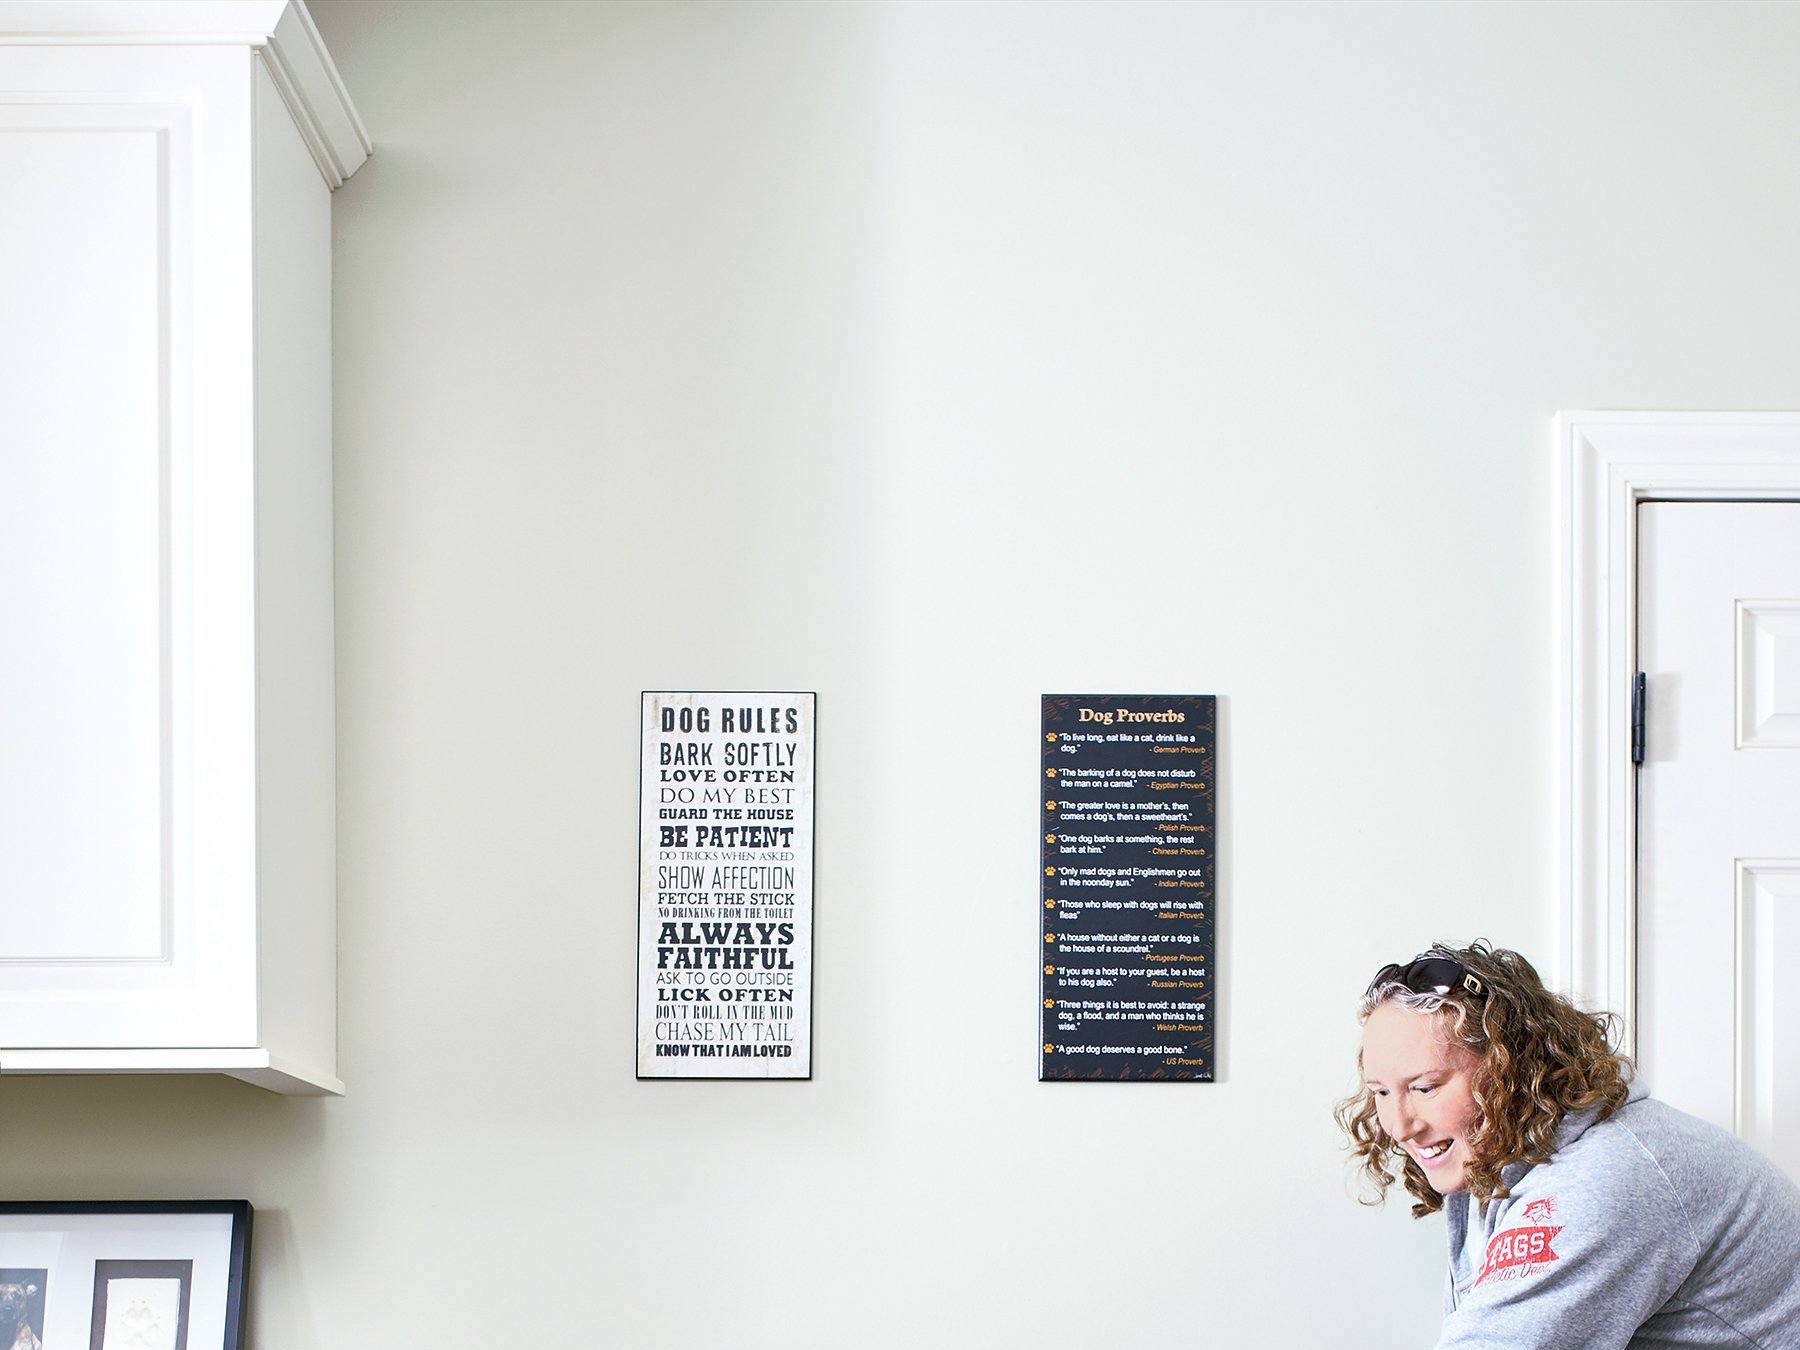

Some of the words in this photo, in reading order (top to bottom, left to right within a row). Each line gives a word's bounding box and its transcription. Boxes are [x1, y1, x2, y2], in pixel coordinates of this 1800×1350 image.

[661, 707, 710, 733] DOG
[722, 708, 797, 733] RULES
[1079, 709, 1113, 725] Dog
[1117, 709, 1185, 723] Proverbs
[1073, 733, 1085, 741] live
[1106, 734, 1119, 742] eat
[1156, 734, 1174, 742] drink
[1176, 734, 1189, 742] like
[660, 743, 712, 766] BARK
[725, 742, 796, 766] SOFTLY
[660, 770, 716, 782] LOVE
[724, 770, 794, 782] OFTEN
[1078, 769, 1105, 778] barking
[1106, 769, 1114, 777] of
[1122, 769, 1136, 779] dog
[1137, 769, 1156, 777] does
[1170, 769, 1196, 777] disturb
[1151, 782, 1179, 790] Egyptian
[661, 788, 694, 803] DO
[703, 788, 736, 803] MY
[745, 788, 795, 804] BEST
[660, 809, 708, 819] GUARD
[713, 809, 742, 819] THE
[747, 809, 794, 820] HOUSE
[660, 825, 688, 847] BE
[696, 826, 794, 848] PATIENT
[1078, 835, 1093, 844] dog
[1094, 835, 1114, 843] barks
[1060, 845, 1077, 853] bark
[660, 851, 676, 860] DO
[680, 851, 718, 860] TRICKS
[722, 852, 756, 861] WHEN
[759, 852, 794, 861] ASKED
[659, 866, 704, 889] SHOW
[712, 866, 794, 889] AFFECTION
[1098, 868, 1116, 877] dogs
[1117, 868, 1131, 876] and
[1133, 868, 1176, 878] Englishmen
[1177, 870, 1187, 878] go
[1060, 878, 1067, 886] in
[1069, 878, 1081, 886] the
[1082, 879, 1114, 888] noonday
[658, 893, 709, 905] FETCH
[714, 893, 745, 905] THE
[750, 893, 794, 905] STICK
[1085, 900, 1101, 908] who
[1102, 901, 1122, 910] sleep
[1140, 901, 1158, 911] dogs
[1160, 901, 1172, 909] will
[1173, 901, 1187, 909] rise
[1188, 901, 1203, 909] with
[658, 907, 669, 918] NO
[673, 908, 715, 918] DRINKING
[718, 908, 741, 918] FROM
[745, 908, 761, 918] THE
[764, 908, 793, 918] TOILET
[658, 922, 794, 945] ALWAYS
[658, 947, 794, 970] FAITHFUL
[1066, 969, 1080, 977] you
[1120, 968, 1127, 976] to
[1129, 969, 1145, 977] your
[1171, 968, 1181, 976] be
[1189, 968, 1205, 976] host
[656, 972, 681, 985] ASK
[686, 972, 705, 985] TO
[710, 972, 731, 985] GO
[736, 972, 793, 985] OUTSIDE
[1059, 978, 1067, 986] to
[1068, 978, 1079, 986] his
[1080, 978, 1095, 988] dog
[1151, 980, 1177, 988] Russian
[658, 988, 711, 1001] LICK
[719, 989, 793, 1002] OFTEN
[656, 1005, 688, 1019] DON'T
[694, 1005, 722, 1019] ROLL
[728, 1006, 737, 1019] IN
[743, 1006, 765, 1019] THE
[771, 1006, 793, 1020] MUD
[656, 1022, 714, 1041] CHASE
[720, 1023, 747, 1041] MY
[753, 1023, 793, 1041] TAIL
[656, 1044, 690, 1057] KNOW
[692, 1045, 724, 1057] THAT
[726, 1045, 730, 1057] I
[732, 1045, 751, 1057] AM
[754, 1045, 792, 1057] LOVED
[1066, 1045, 1085, 1055] good
[1086, 1045, 1100, 1055] dog
[1102, 1045, 1135, 1054] deserves
[1144, 1046, 1162, 1056] good
